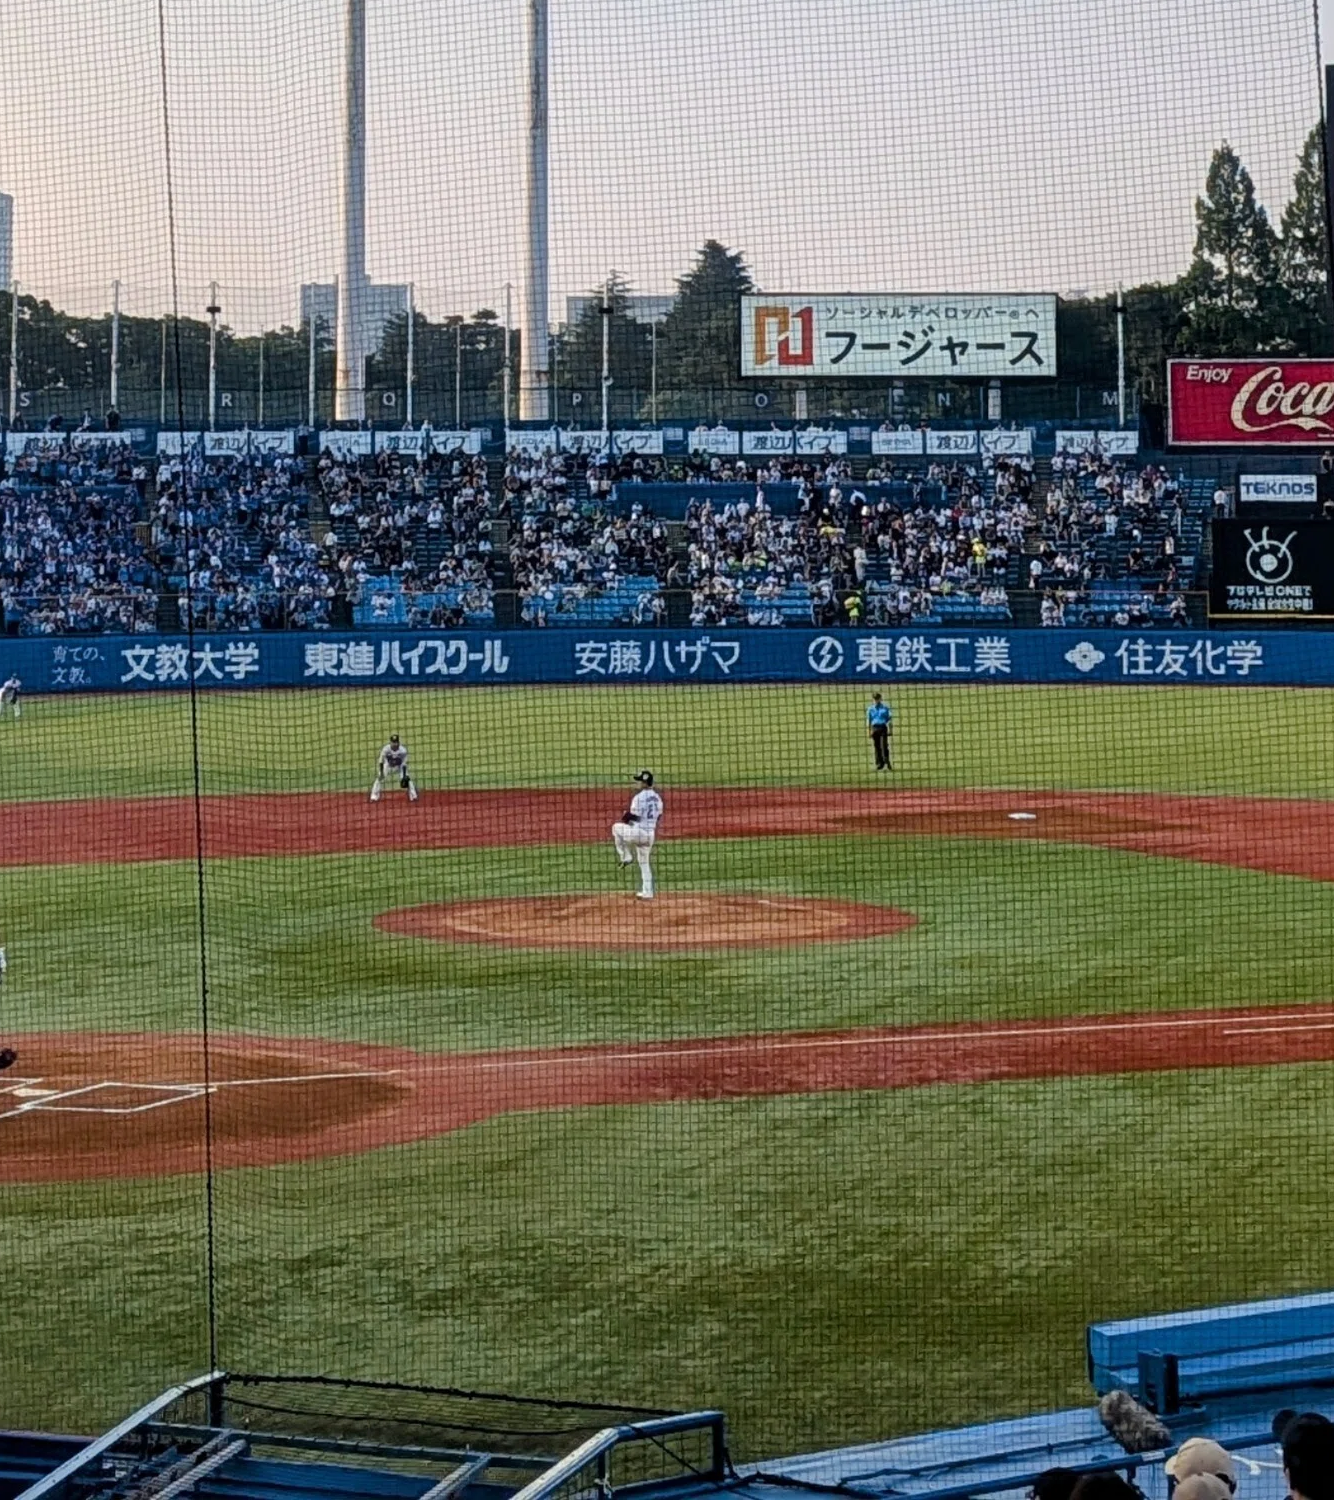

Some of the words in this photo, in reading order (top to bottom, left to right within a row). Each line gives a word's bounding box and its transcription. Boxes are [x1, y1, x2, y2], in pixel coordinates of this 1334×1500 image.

[825, 325, 1044, 367] フージャース
[1186, 365, 1233, 383] Enjoy
[20, 392, 30, 407] S
[221, 392, 233, 407] R
[572, 393, 582, 407] P
[937, 392, 951, 407] N
[1241, 481, 1316, 496] TEKNOS
[120, 641, 260, 684] 文教大学
[304, 639, 509, 676] 東進ハイスクール
[574, 636, 741, 675] 安藤ハザマ
[855, 636, 1012, 675] 東鉄工業
[1114, 637, 1264, 676] 住友化学
